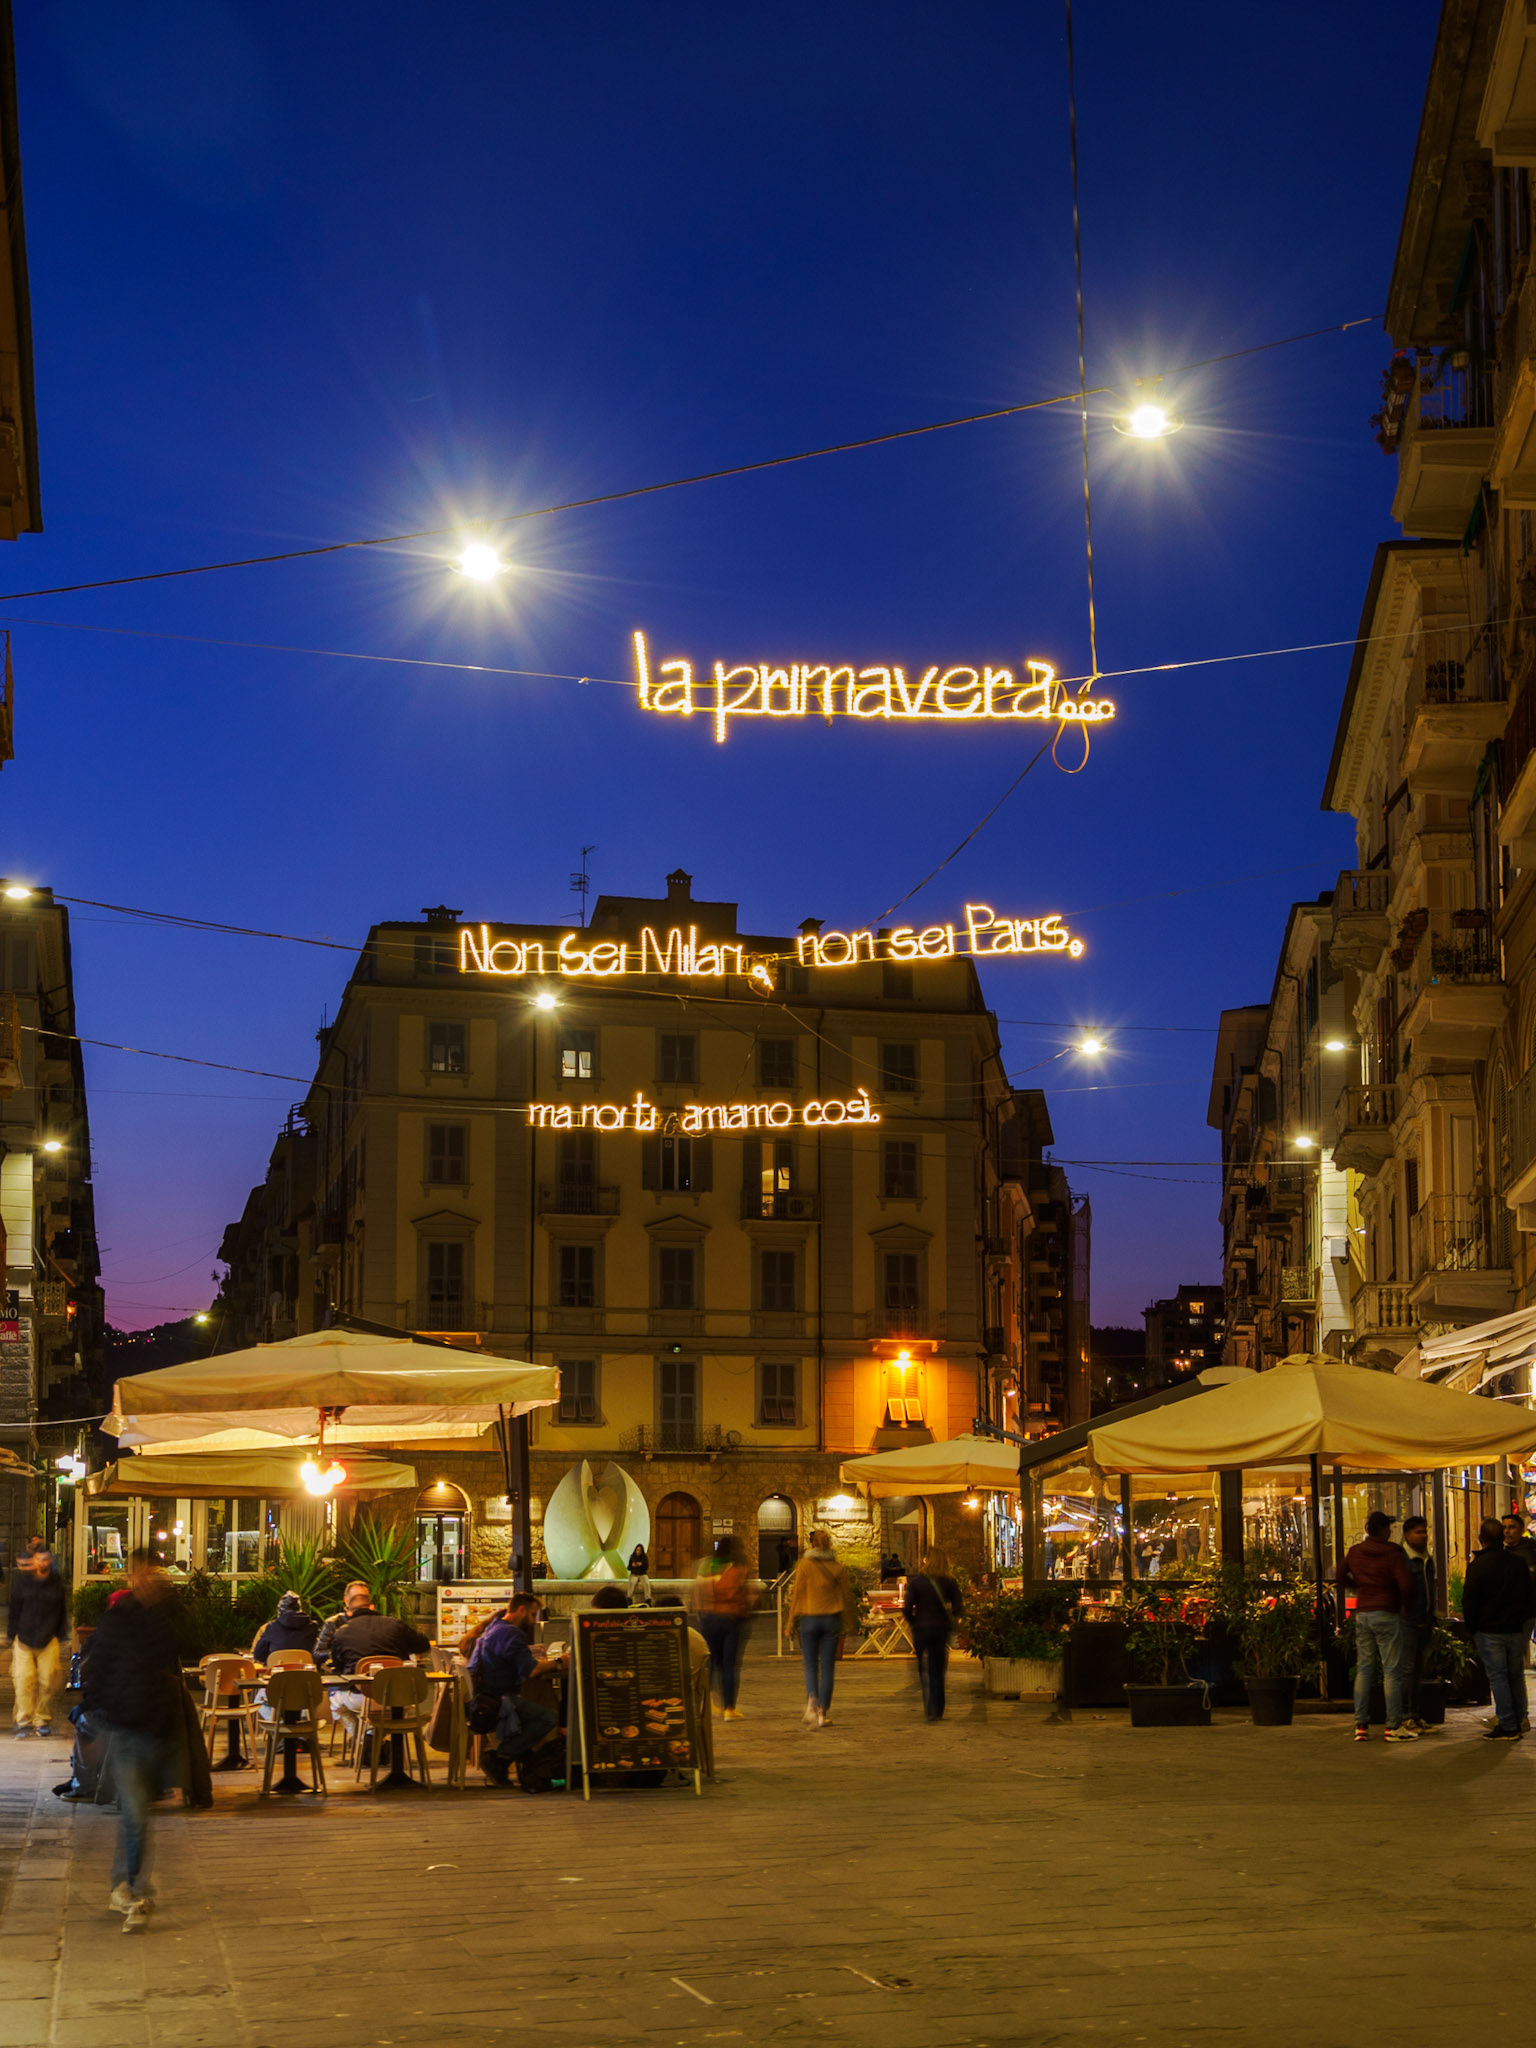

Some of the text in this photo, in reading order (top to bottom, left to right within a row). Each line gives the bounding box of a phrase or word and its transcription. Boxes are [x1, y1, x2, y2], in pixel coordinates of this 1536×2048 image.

[460, 924, 545, 975] Non
[796, 931, 875, 967] non
[887, 922, 956, 961] sei
[528, 1104, 573, 1130] ma
[682, 1102, 792, 1132] amiamo
